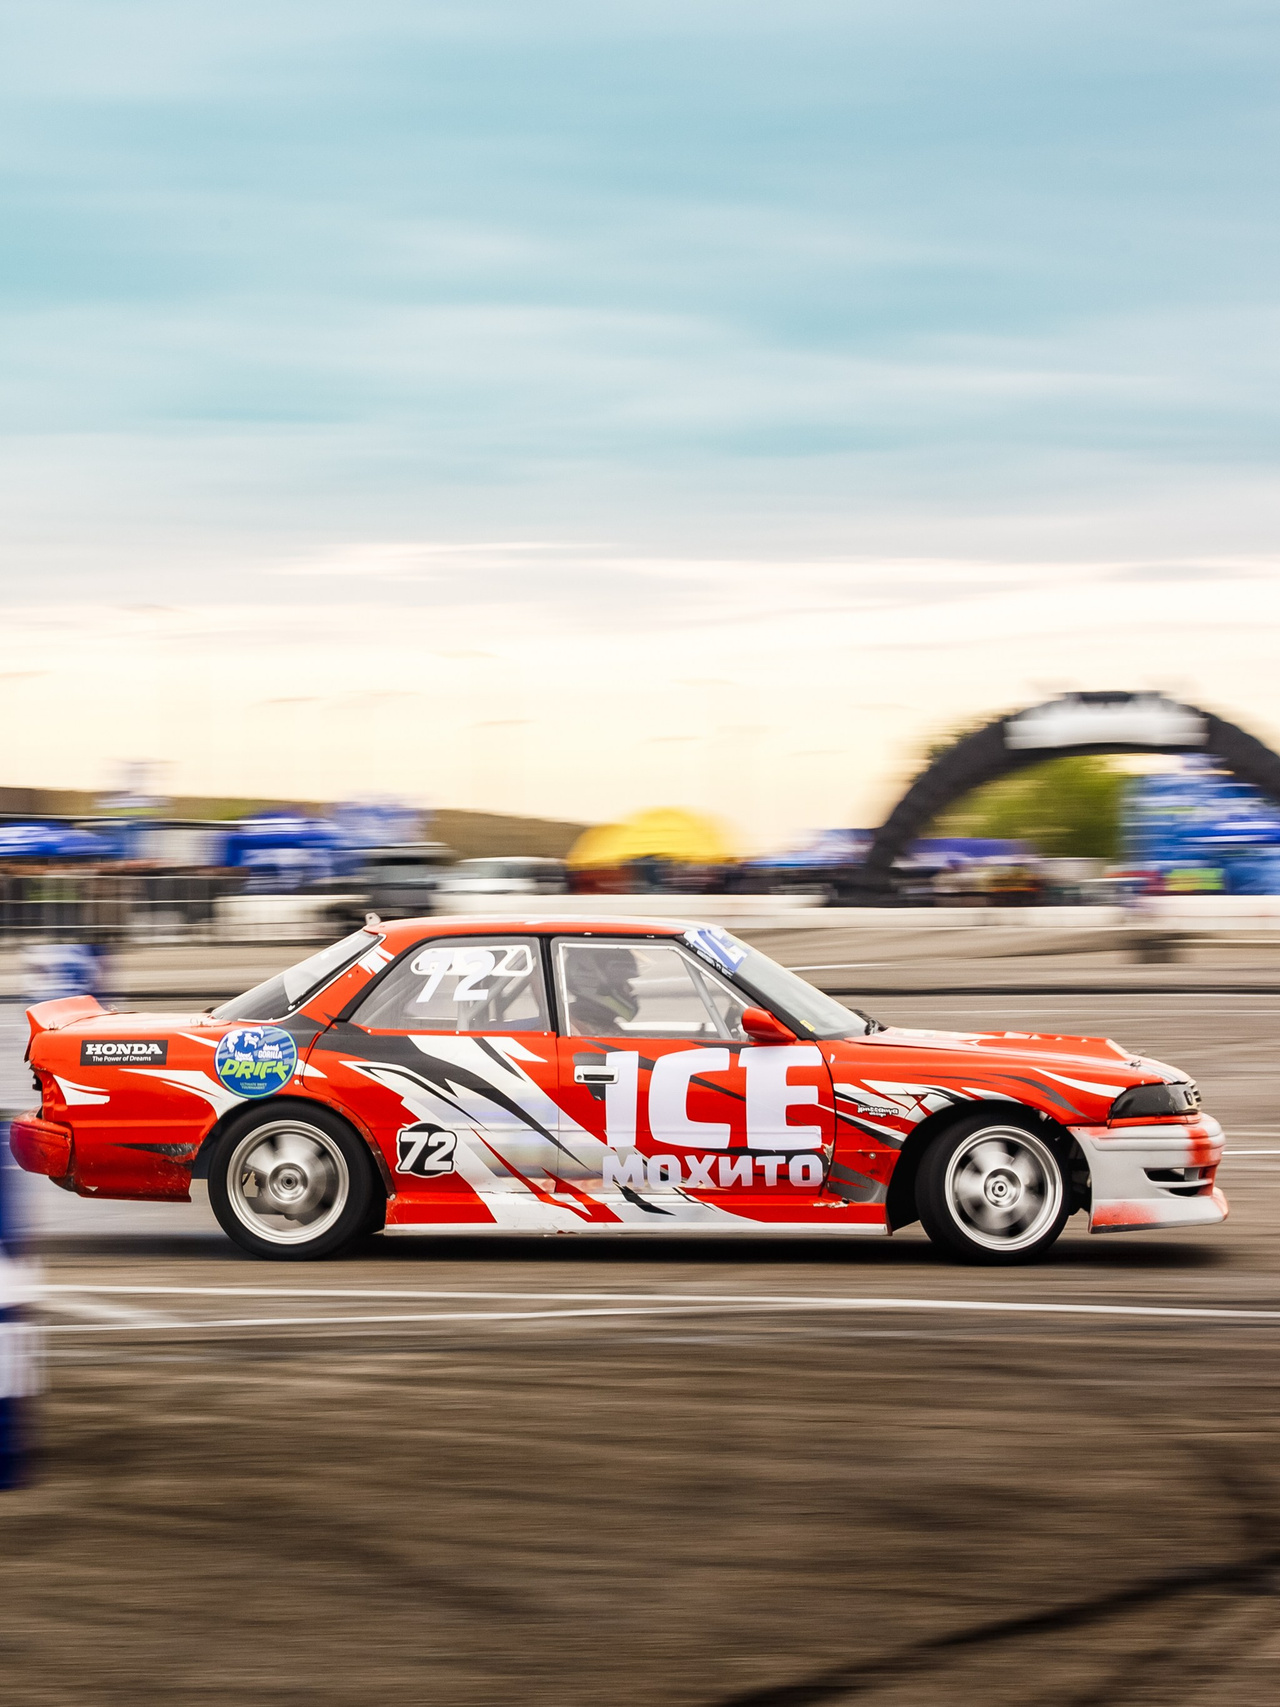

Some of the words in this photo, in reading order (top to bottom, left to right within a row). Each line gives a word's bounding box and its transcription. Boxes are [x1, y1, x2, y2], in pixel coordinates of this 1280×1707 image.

[416, 949, 496, 1004] 72
[85, 1043, 163, 1055] HONDA
[104, 1055, 121, 1063] Power
[257, 1050, 283, 1059] GORILLA
[220, 1058, 290, 1082] DRIFT
[605, 1045, 823, 1150] ICE
[399, 1131, 457, 1171] 72
[602, 1153, 824, 1190] МОХИТО
